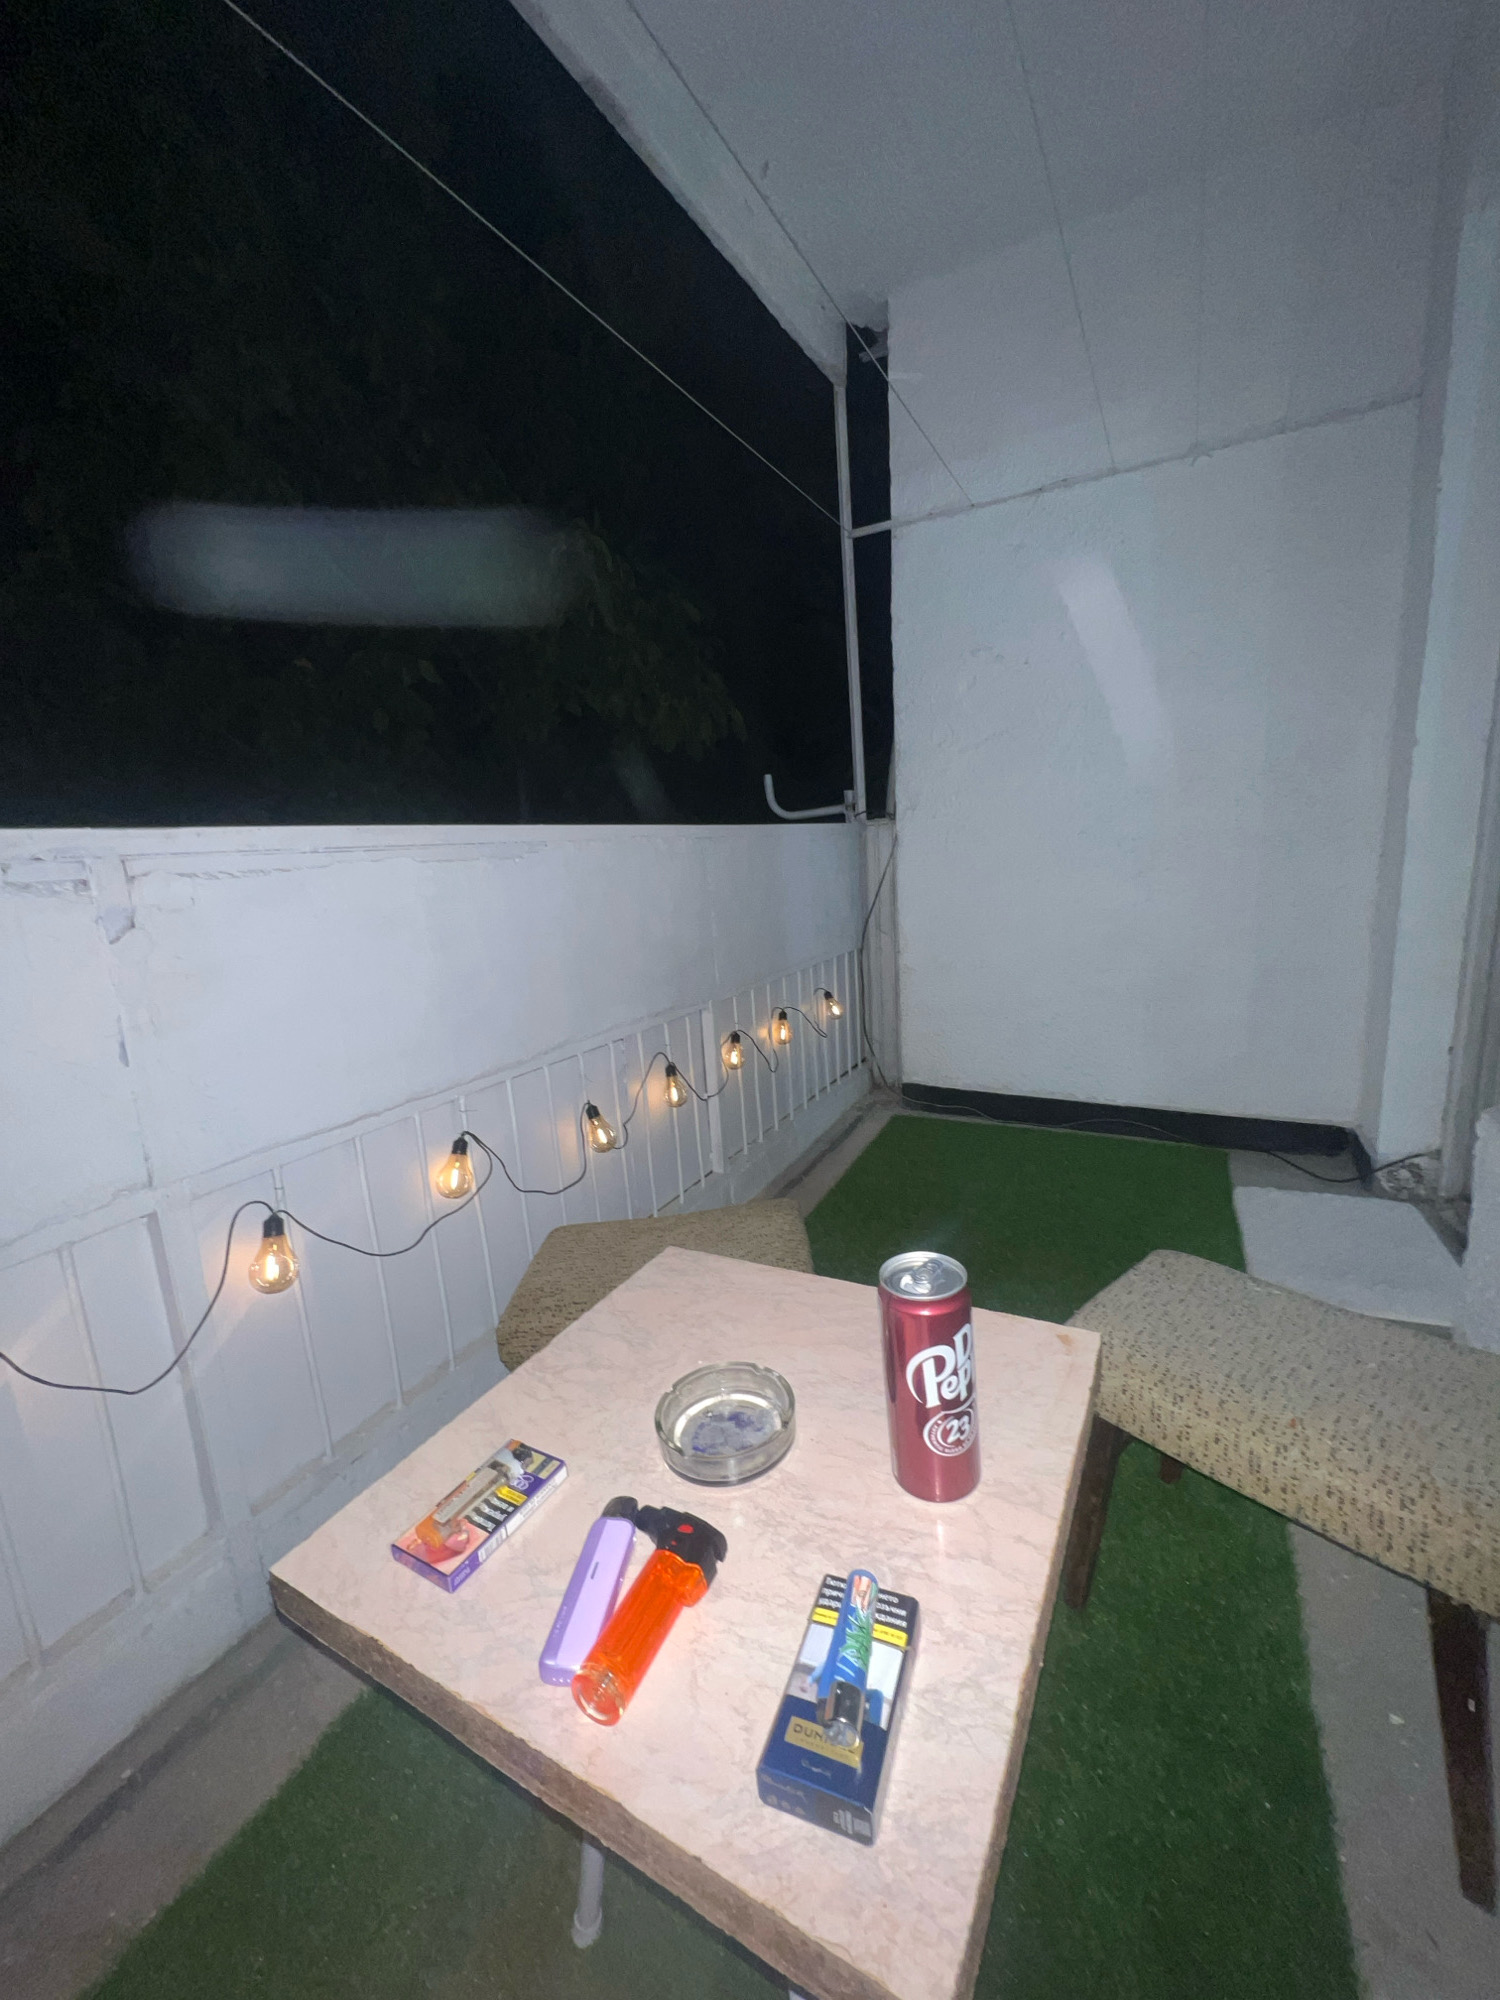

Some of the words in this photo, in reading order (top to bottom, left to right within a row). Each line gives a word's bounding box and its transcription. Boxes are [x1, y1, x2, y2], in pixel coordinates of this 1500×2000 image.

[952, 1323, 972, 1370] D
[905, 1344, 972, 1409] Pep
[946, 1415, 971, 1444] 23
